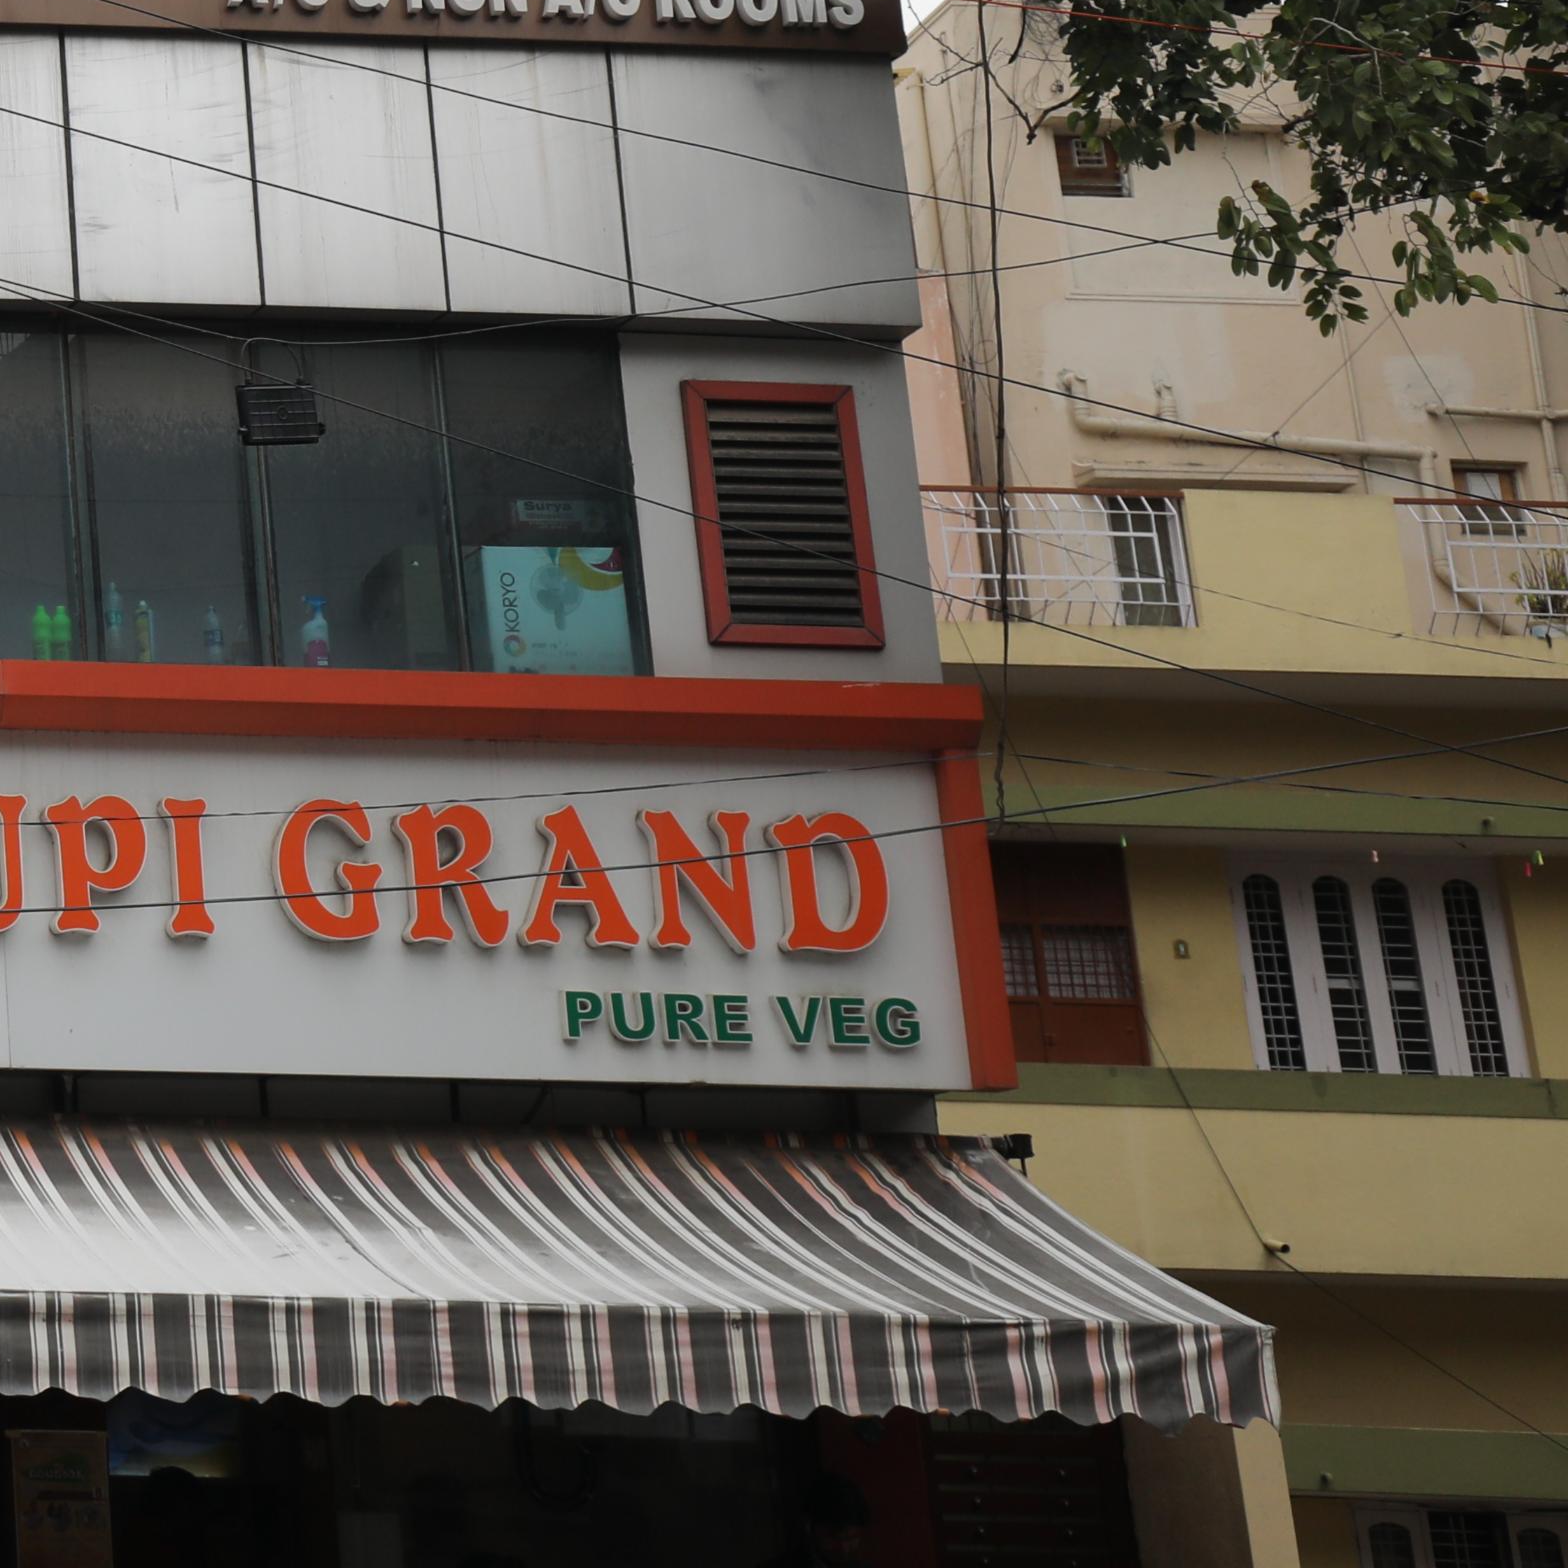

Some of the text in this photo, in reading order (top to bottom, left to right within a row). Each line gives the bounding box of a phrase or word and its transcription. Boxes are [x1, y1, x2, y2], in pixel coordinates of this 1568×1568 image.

[500, 571, 521, 633] KORYO
[272, 797, 890, 955] GRAND
[561, 989, 923, 1050] PURE VEG
